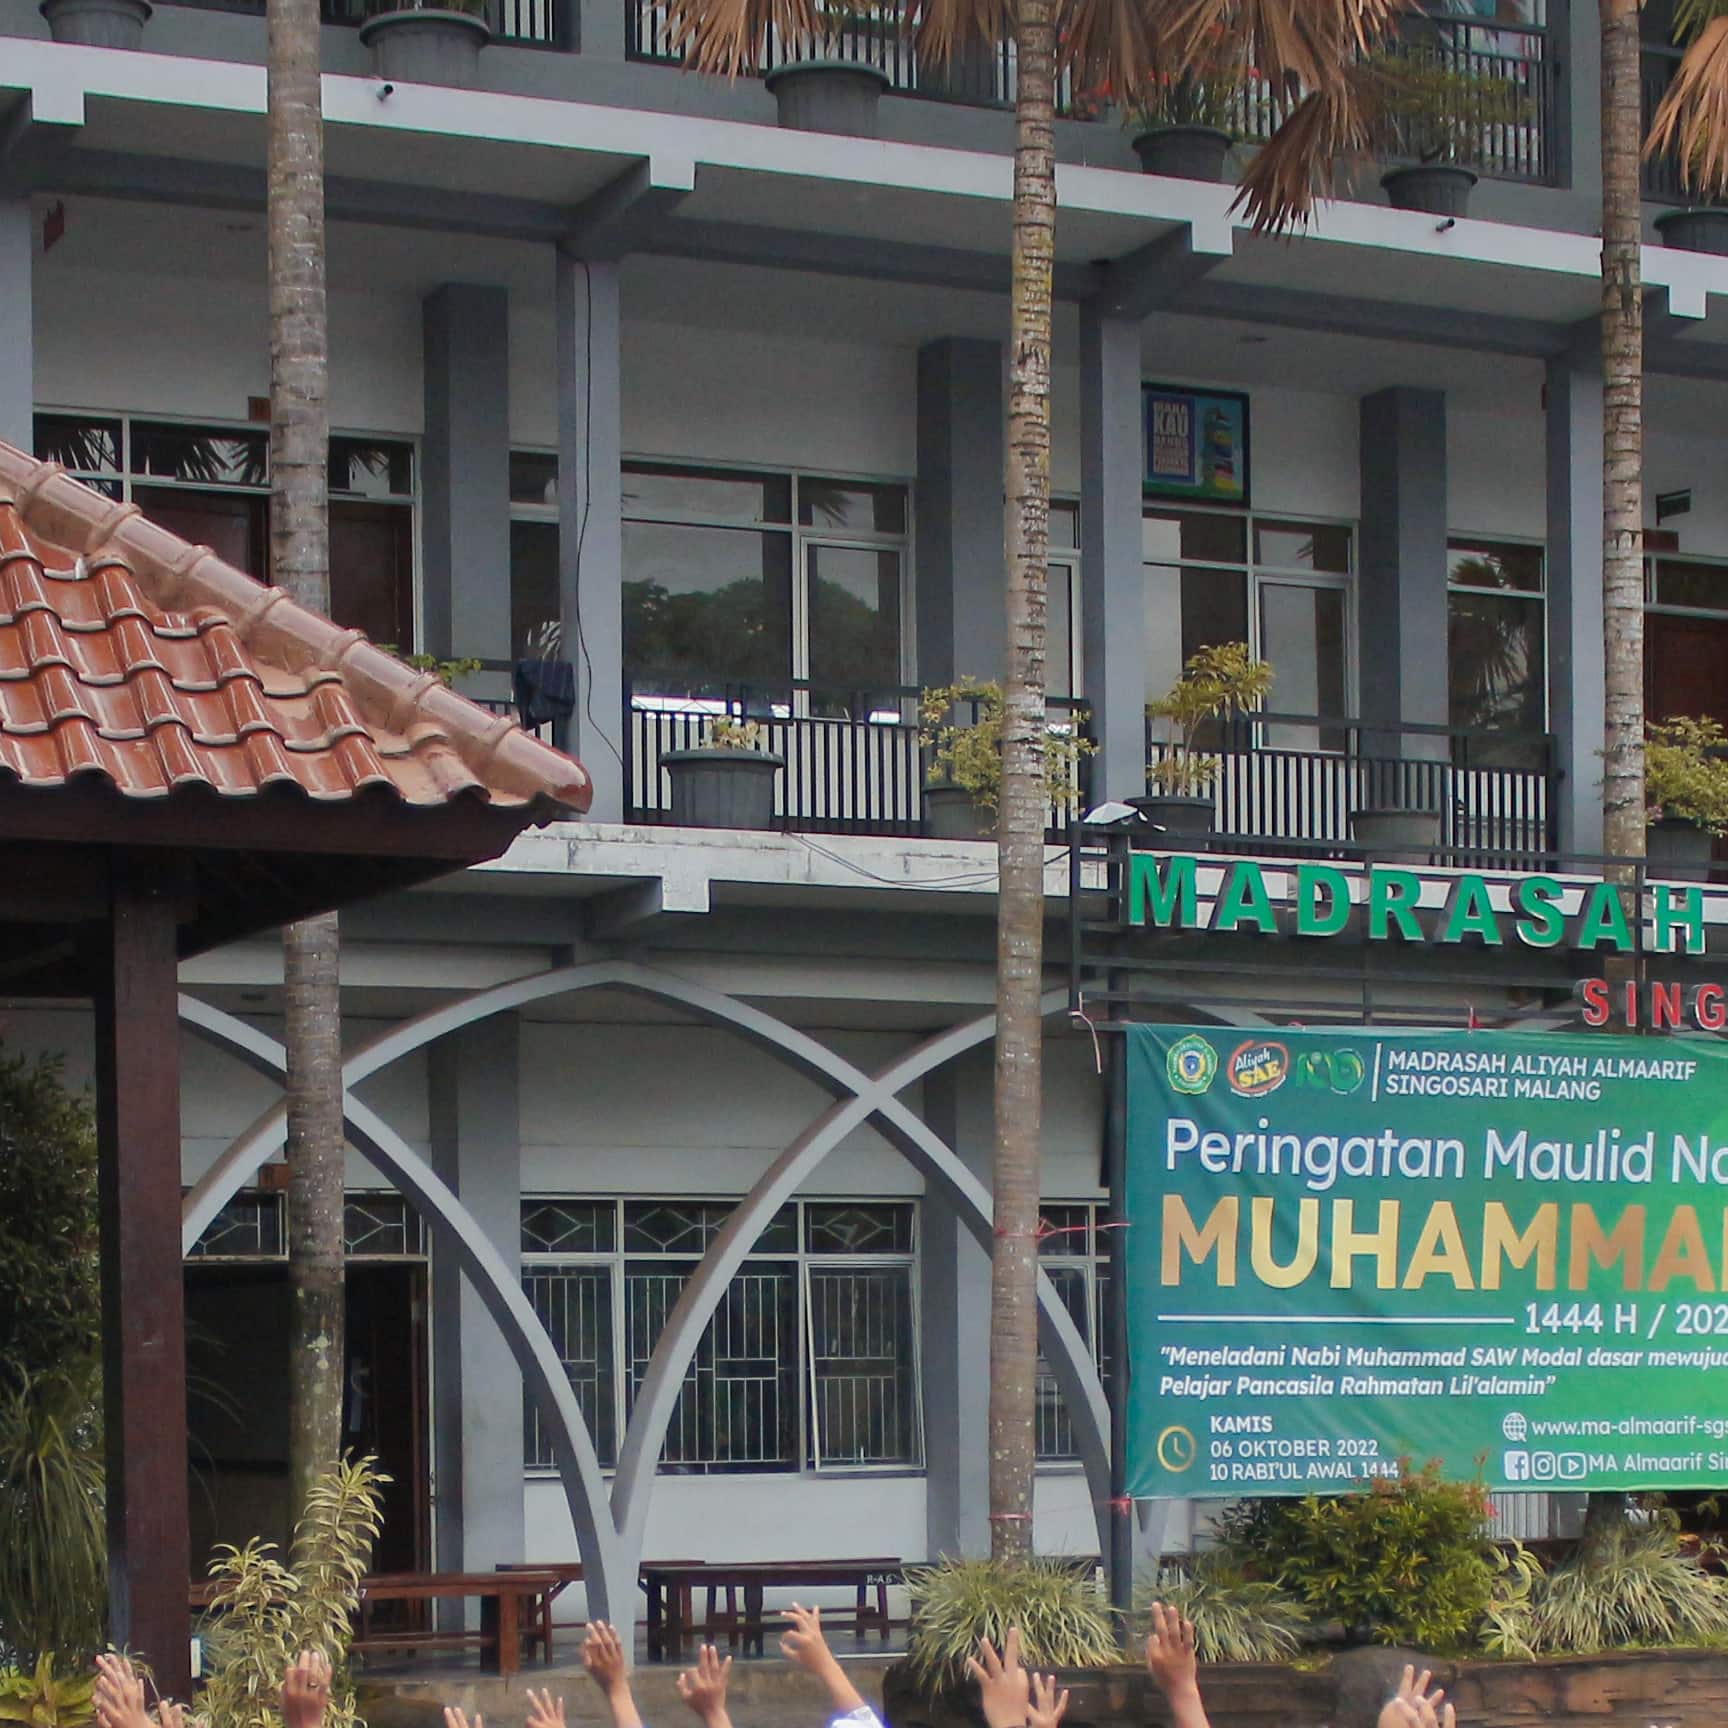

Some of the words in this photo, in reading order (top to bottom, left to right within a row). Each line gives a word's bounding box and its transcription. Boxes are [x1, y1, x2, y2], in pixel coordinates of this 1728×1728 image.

[1128, 854, 1705, 954] MADRASAH
[1235, 1048, 1270, 1072] Aliyah
[1389, 1050, 1508, 1075] MADRASAH
[1510, 1055, 1591, 1077] ALIYAH
[1594, 1058, 1696, 1080] ALMAARIF
[1237, 1061, 1282, 1088] SAE
[1386, 1074, 1509, 1098] SINGOSARI
[1514, 1078, 1601, 1101] MALANG
[1166, 1118, 1464, 1190] Peringatan
[1485, 1129, 1654, 1184] Maulid
[1525, 1303, 1603, 1335] 1444
[1615, 1304, 1637, 1334] H
[1647, 1303, 1667, 1339] /
[1291, 1345, 1342, 1367] Nabi
[1347, 1347, 1465, 1367] Muhammad
[1471, 1348, 1518, 1367] SAW
[1522, 1347, 1582, 1367] Modal
[1587, 1347, 1644, 1367] dasar
[1160, 1375, 1232, 1401] Pelajar
[1237, 1375, 1334, 1395] Pancasila
[1341, 1376, 1444, 1395] Rahmatan
[1210, 1415, 1273, 1433] KAMIS
[1210, 1441, 1232, 1458] 06
[1238, 1440, 1330, 1458] OKTOBER
[1337, 1440, 1378, 1456] 2022
[1589, 1453, 1617, 1472] MA
[1624, 1452, 1702, 1472] Almaarif
[1210, 1464, 1228, 1480] 10
[1306, 1462, 1355, 1479] AWAL
[1362, 1461, 1400, 1478] 1444
